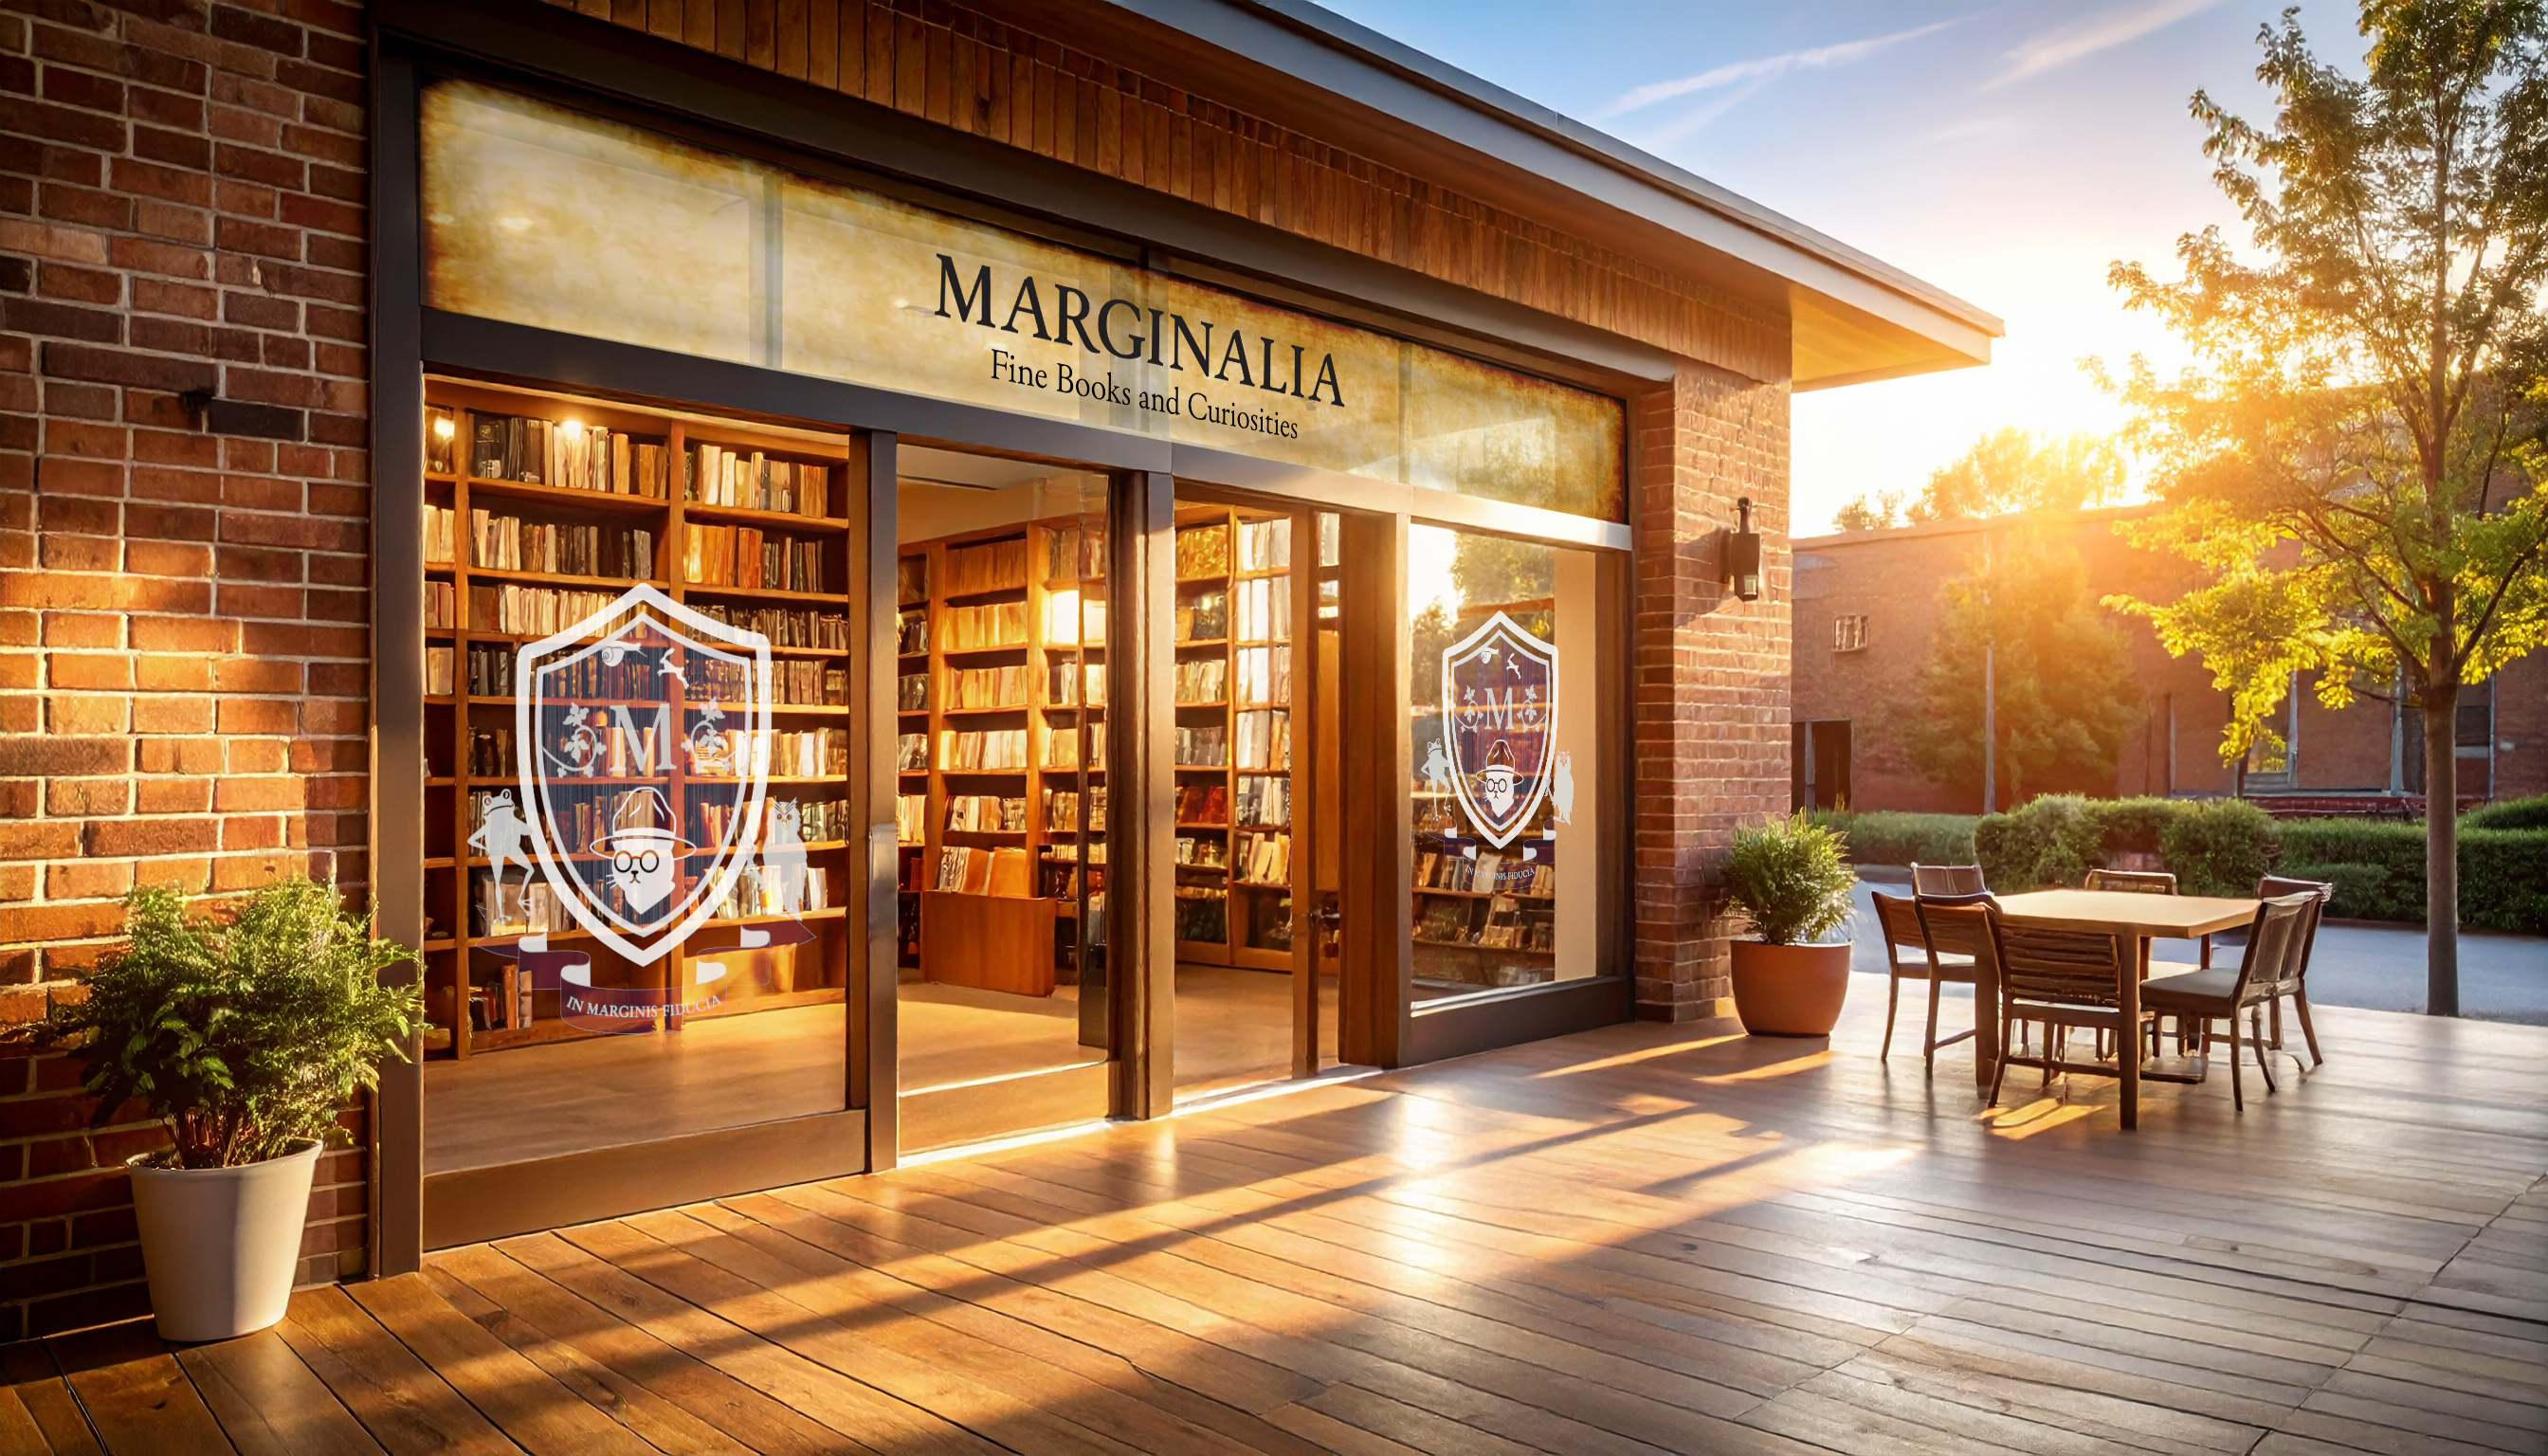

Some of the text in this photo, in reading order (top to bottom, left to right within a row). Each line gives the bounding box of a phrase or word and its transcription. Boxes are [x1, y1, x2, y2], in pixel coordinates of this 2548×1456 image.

[936, 253, 1345, 408] MARGINALIA
[991, 348, 1299, 440] Fine Books and Curiosities
[609, 702, 678, 774] M
[1483, 687, 1516, 731] M
[1465, 864, 1536, 881] IN MARGINIS FIDUCIA
[566, 994, 722, 1019] IN MARGINIS FIDUCIA
